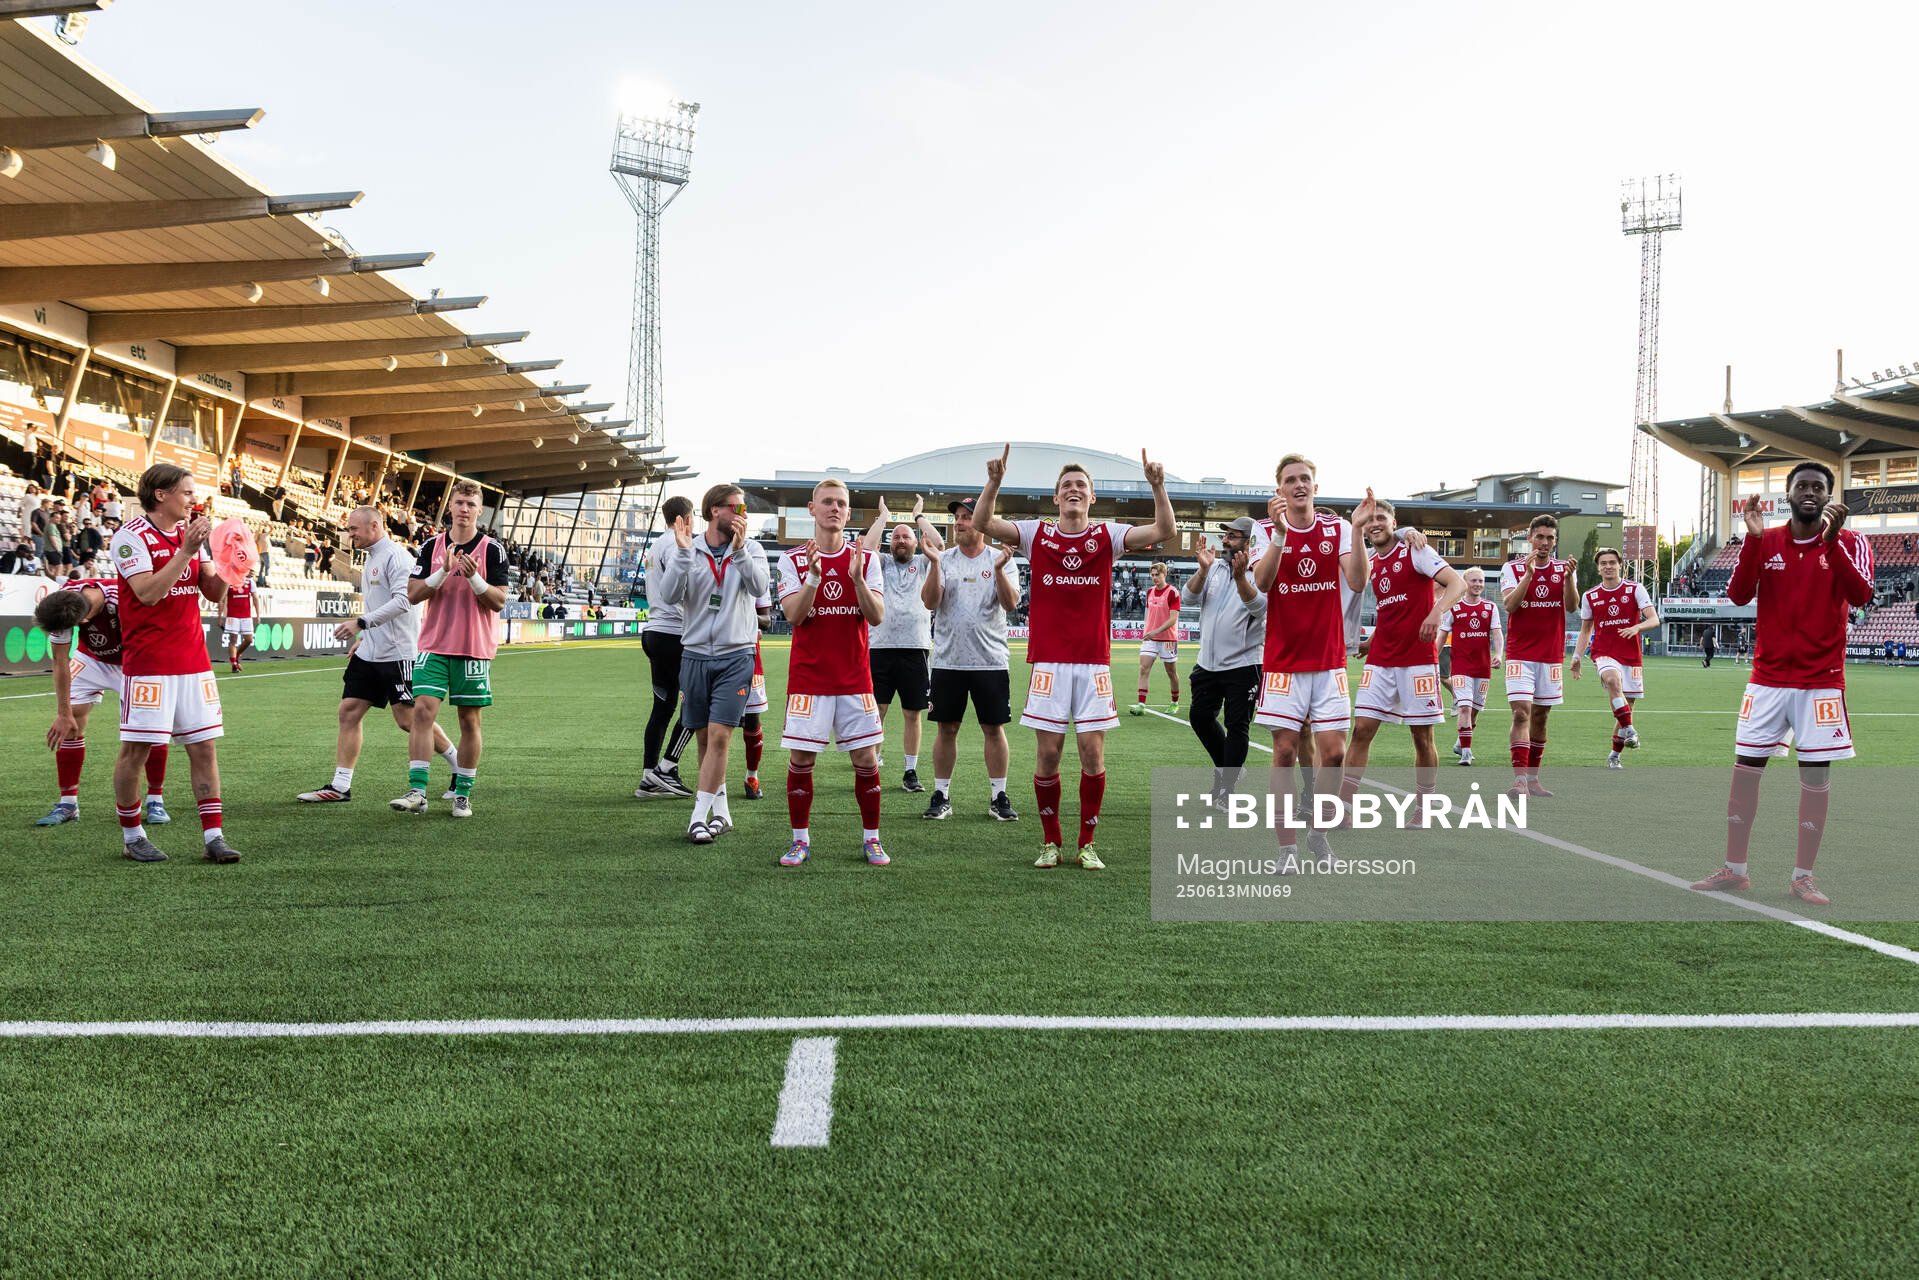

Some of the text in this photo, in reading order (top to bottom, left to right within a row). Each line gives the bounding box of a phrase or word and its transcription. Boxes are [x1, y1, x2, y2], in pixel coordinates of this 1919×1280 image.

[34, 306, 47, 324] vi
[130, 345, 147, 360] ett
[272, 398, 285, 410] och
[1732, 499, 1774, 514] MXI
[1056, 577, 1100, 585] SANDVIK
[1291, 581, 1336, 593] SANDVIK
[1379, 593, 1408, 607] SANDVIK
